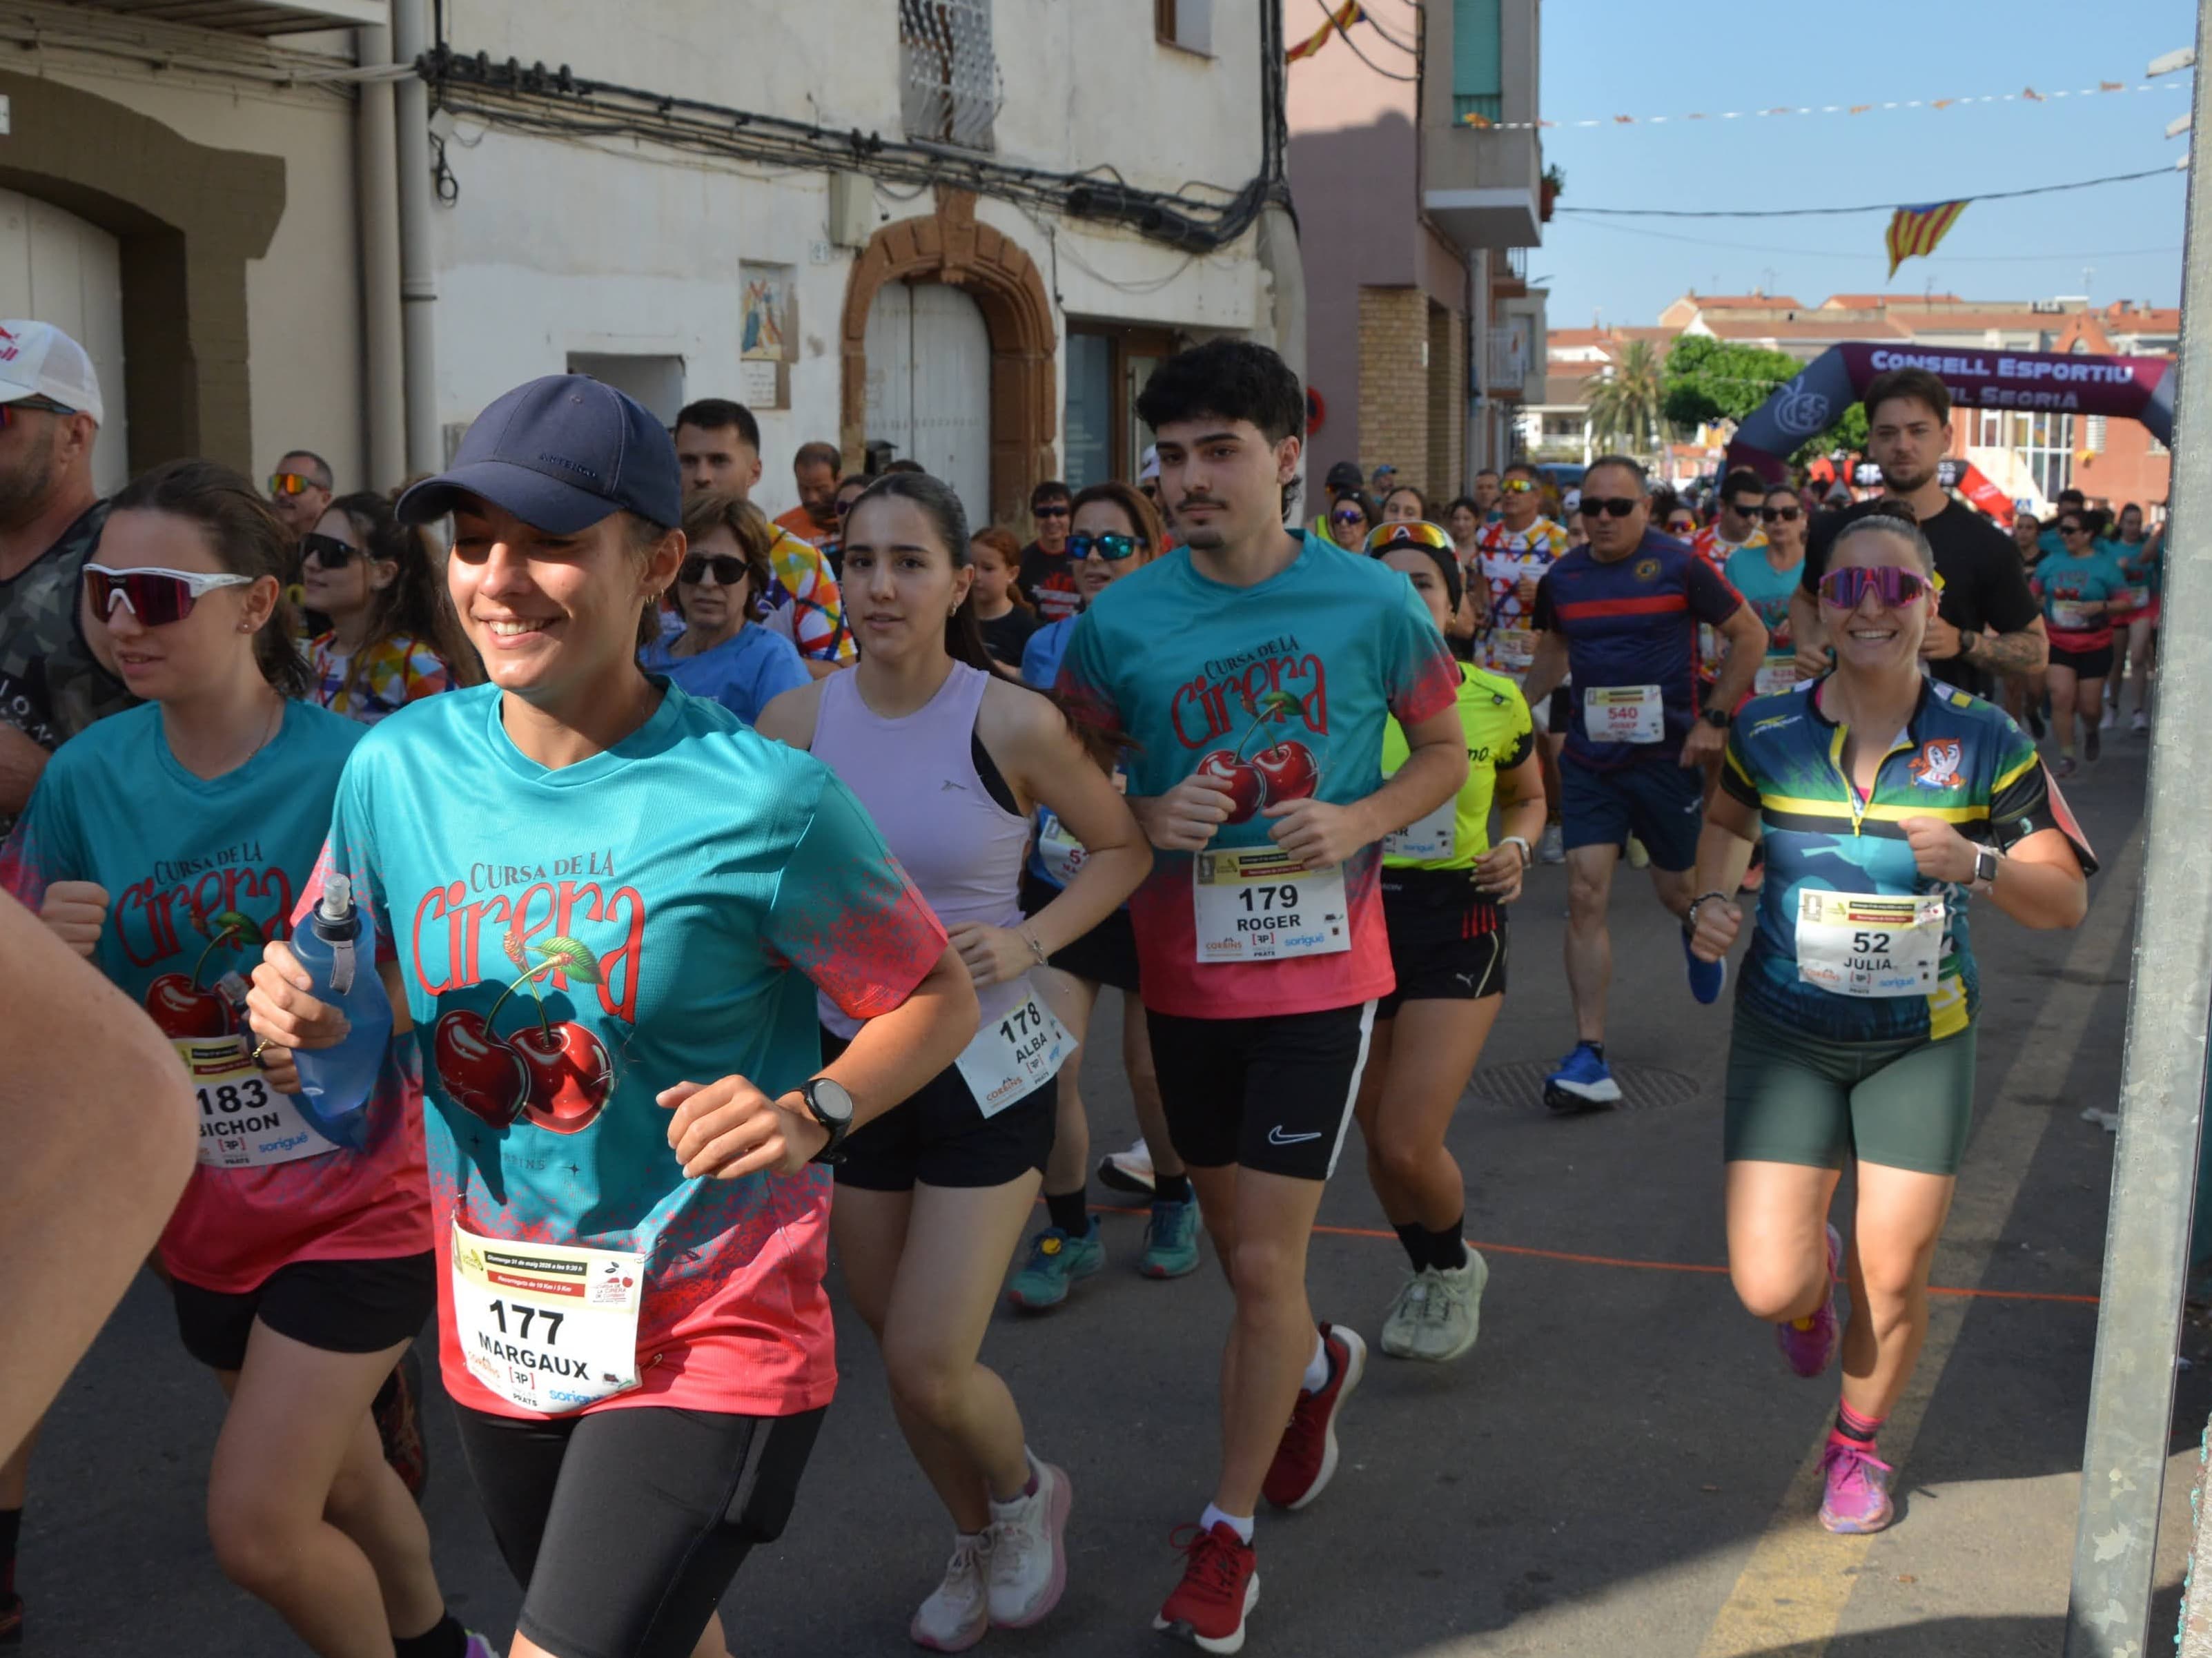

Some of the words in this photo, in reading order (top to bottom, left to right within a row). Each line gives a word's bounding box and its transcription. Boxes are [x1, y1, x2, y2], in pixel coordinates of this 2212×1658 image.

[1870, 351, 1990, 376] CONSELL
[1997, 358, 2133, 383] ESPORTIU
[1946, 387, 1972, 402] EL
[1205, 652, 1255, 680] CURSA
[1257, 640, 1279, 656] DE
[1280, 634, 1301, 652] LA
[1608, 706, 1638, 719] 540
[153, 855, 215, 886] CURSA
[217, 846, 239, 864] DE
[243, 840, 264, 862] LA
[471, 862, 547, 893] CURSA
[554, 855, 583, 876] DE
[589, 848, 615, 877] LA
[1239, 884, 1299, 911] 179
[1237, 914, 1301, 932] ROGER
[1853, 933, 1890, 953] 52
[999, 1002, 1041, 1044] 178
[1015, 1033, 1048, 1064] ALBA
[197, 1079, 268, 1115] 183
[489, 1298, 565, 1345] 177
[478, 1330, 591, 1381] MARGAUX
